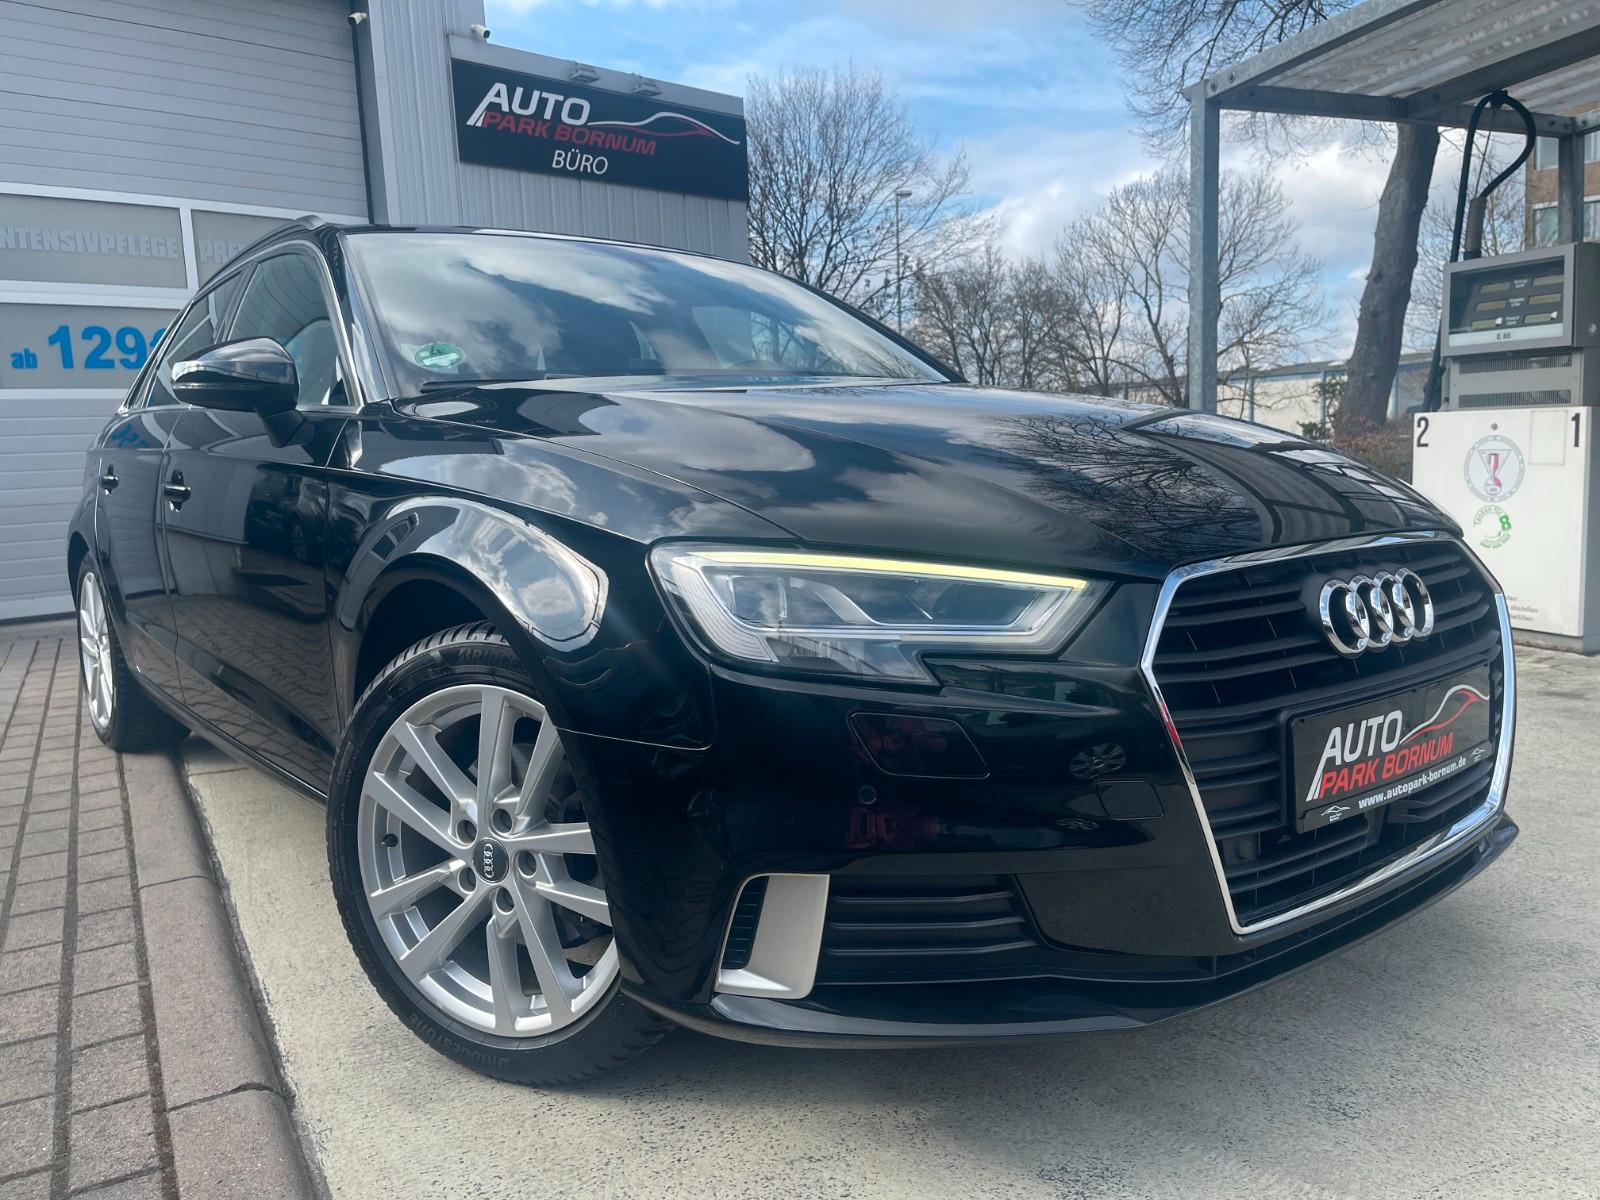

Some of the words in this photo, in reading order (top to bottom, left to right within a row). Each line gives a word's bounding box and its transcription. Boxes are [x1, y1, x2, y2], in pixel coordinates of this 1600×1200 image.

[466, 82, 590, 127] AUTO
[482, 110, 549, 138] PARK
[554, 125, 656, 156] BORNUM
[552, 149, 608, 174] BÜRO
[0, 225, 179, 259] NTENSIVPFLEGE
[199, 239, 249, 264] PRE
[11, 348, 38, 369] ab
[1416, 416, 1429, 447] 2
[1571, 412, 1581, 448] 1
[1305, 709, 1403, 801] AUTO
[1318, 758, 1380, 800] PARK
[1381, 731, 1455, 780] BORNUM
[1358, 756, 1467, 809] www.autopark-bornum.de
